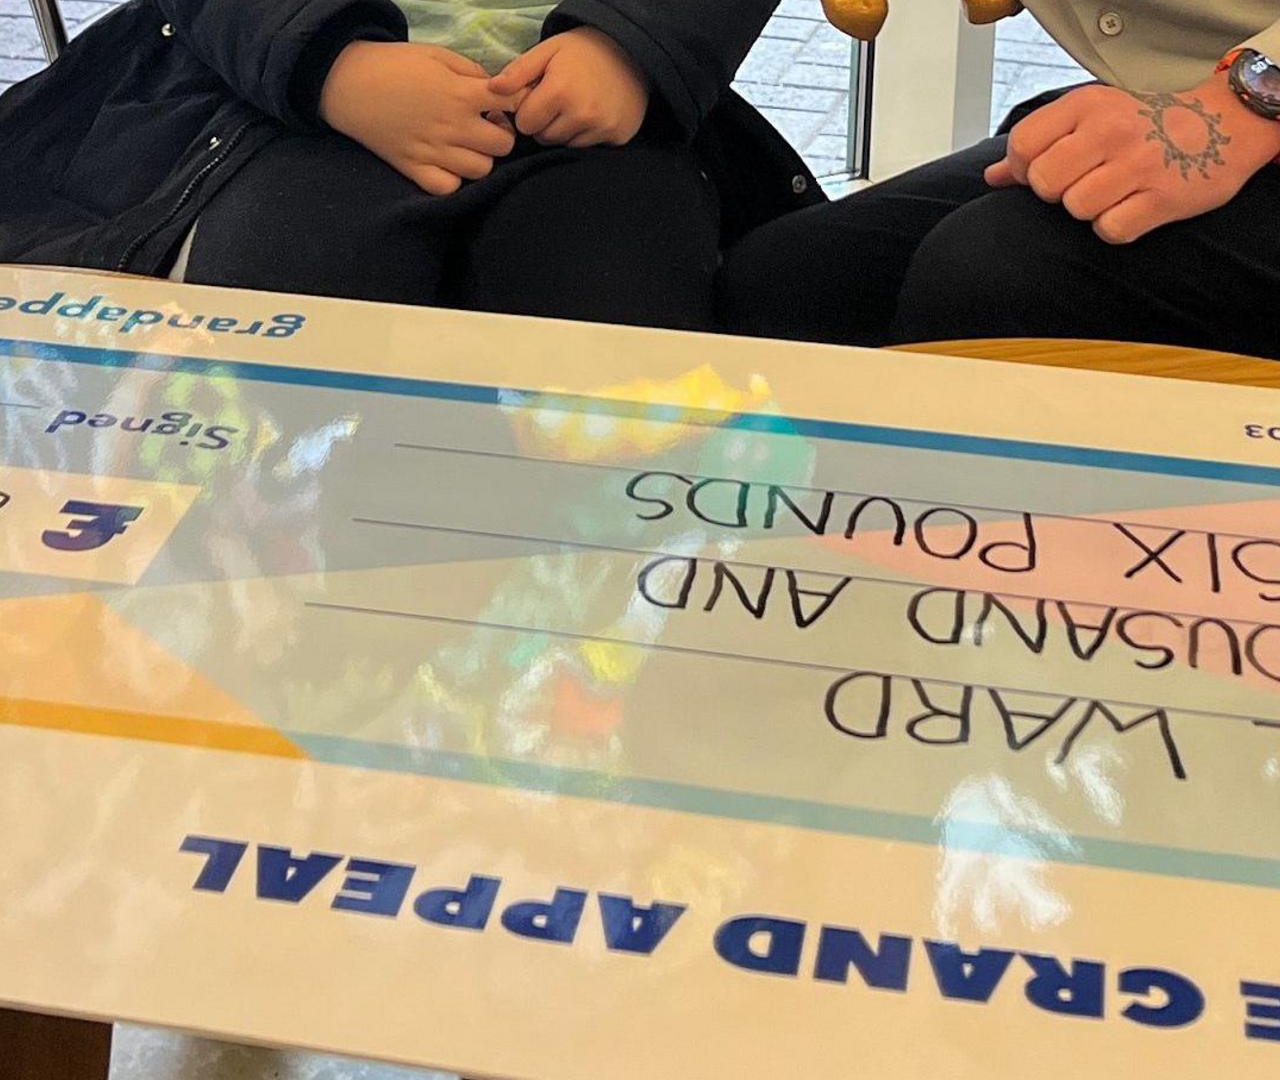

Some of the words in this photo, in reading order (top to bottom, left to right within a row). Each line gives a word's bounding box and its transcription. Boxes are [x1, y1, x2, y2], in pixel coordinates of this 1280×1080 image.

[47, 409, 240, 451] Signed
[40, 499, 144, 552] £
[624, 470, 1036, 573] POUNDS
[637, 557, 852, 628] AND
[824, 670, 1187, 781] WARD
[178, 834, 688, 956] APPEAL
[712, 913, 1206, 1029] GRAND
